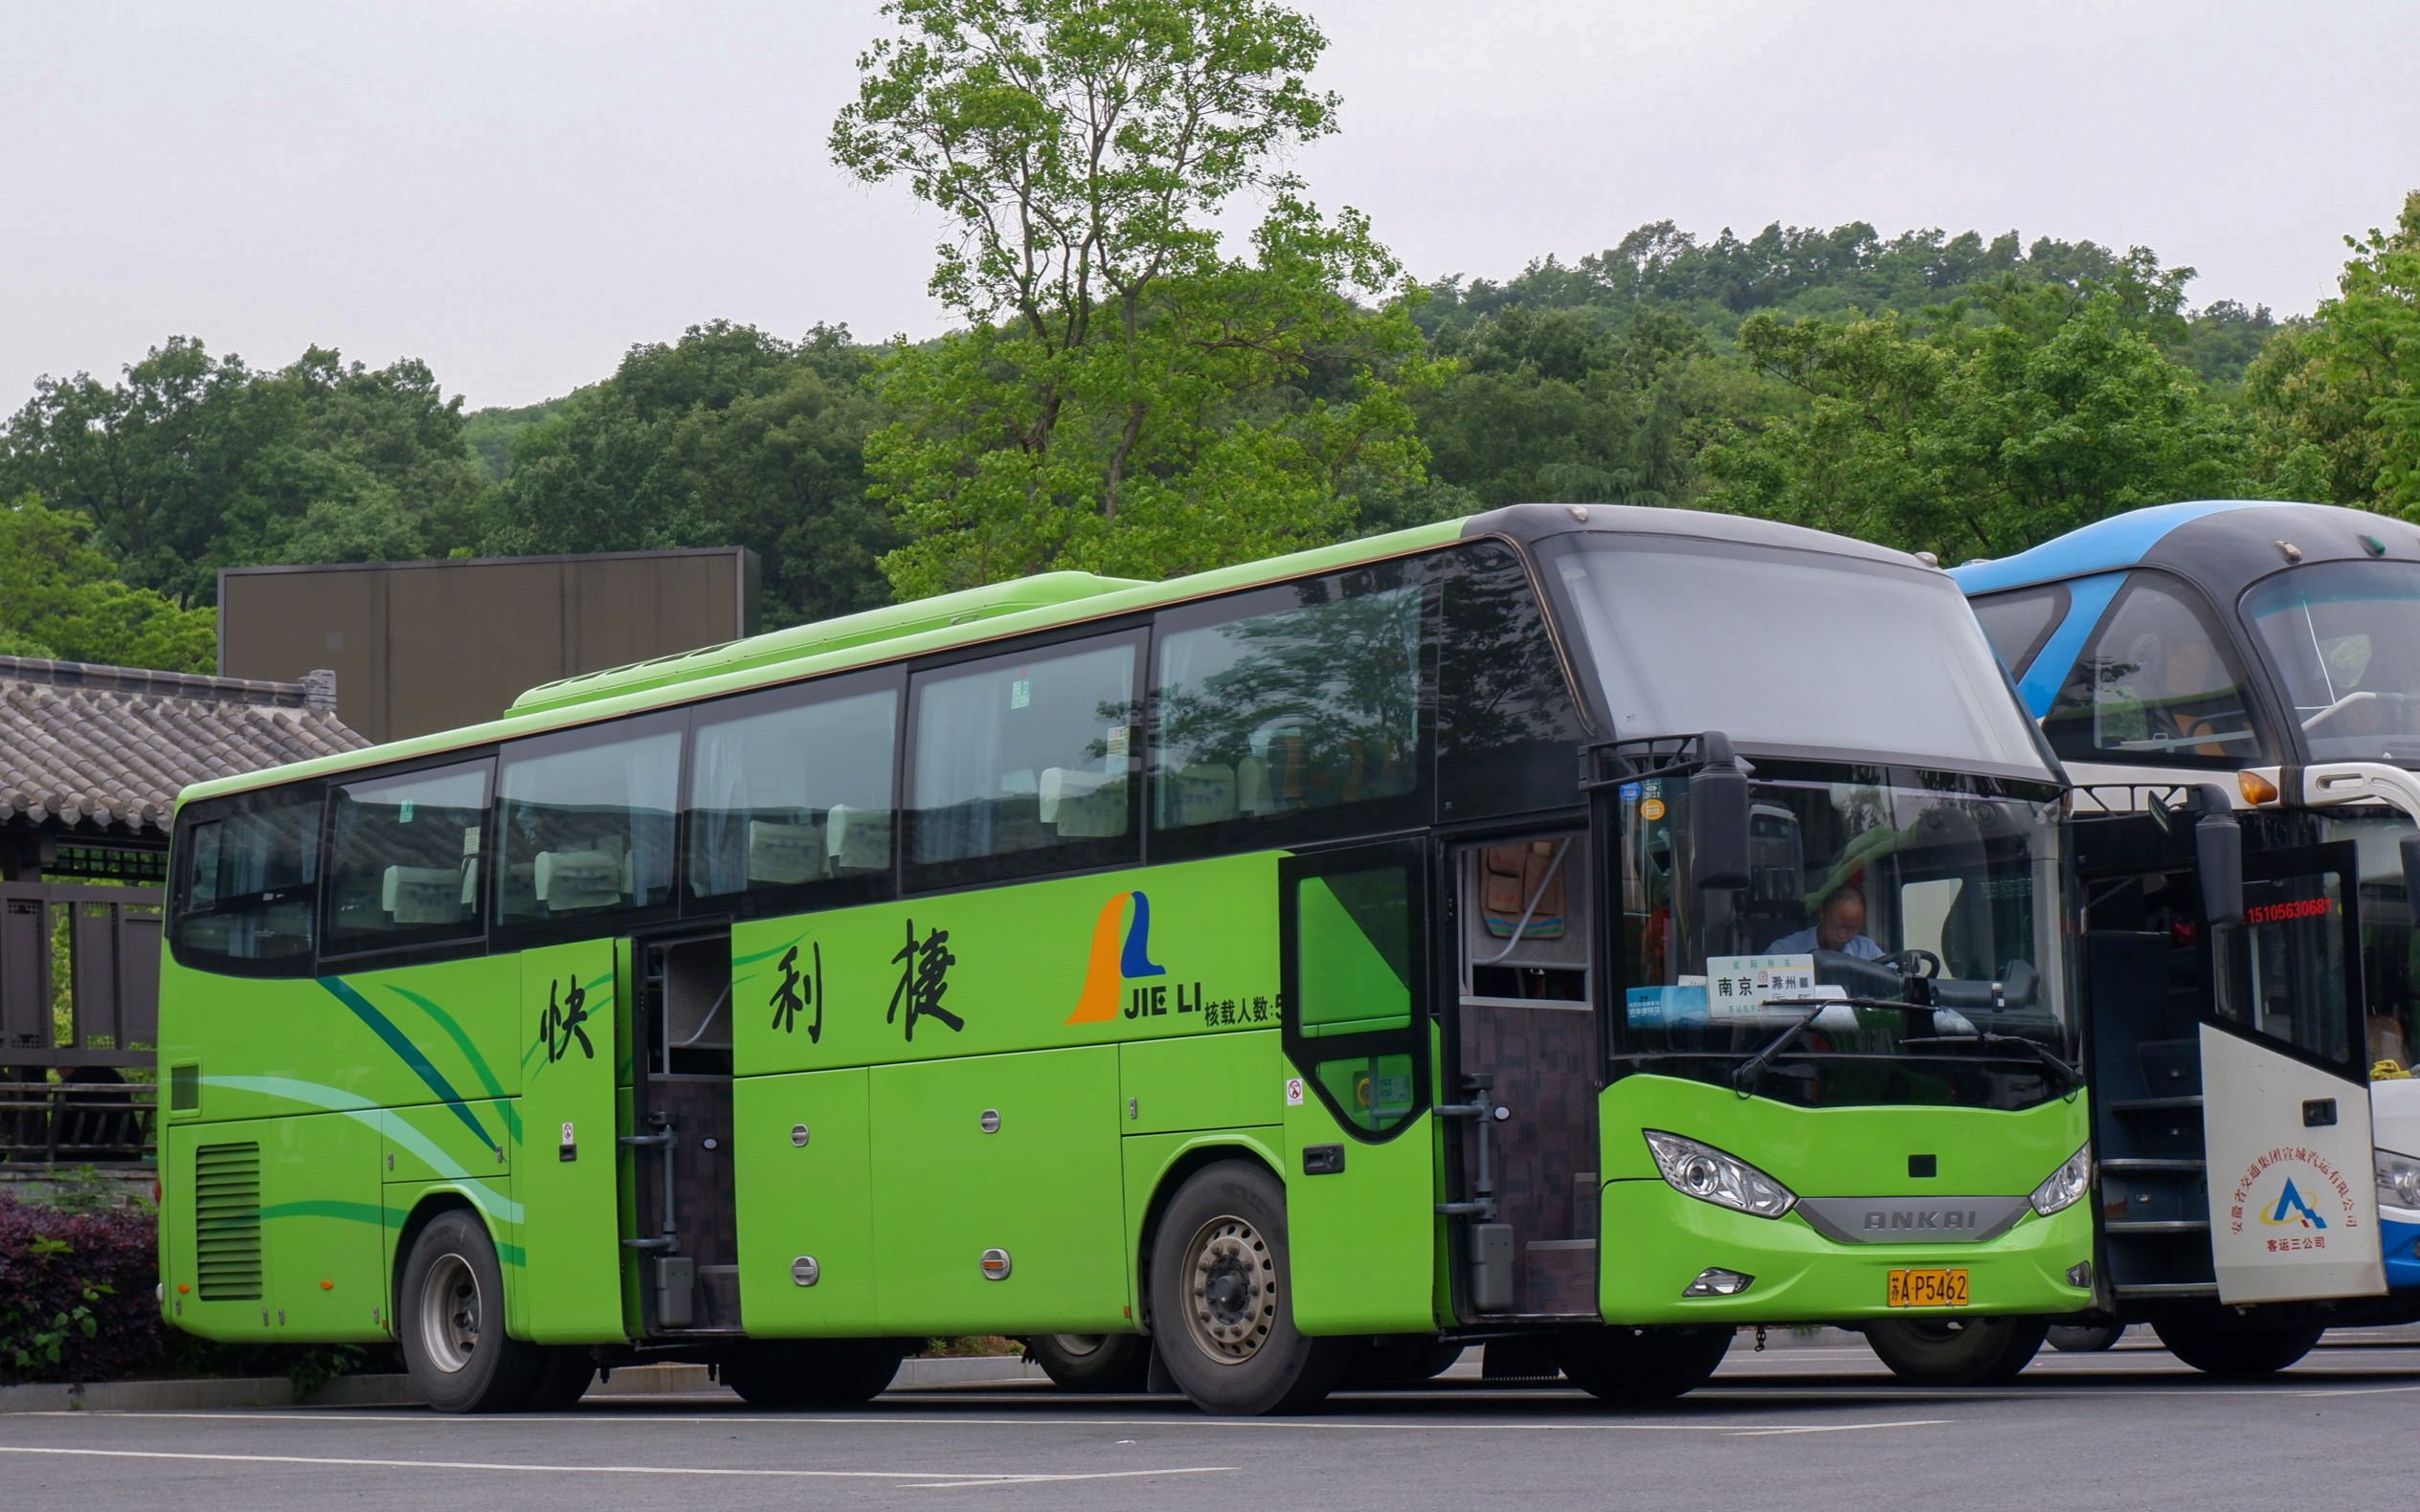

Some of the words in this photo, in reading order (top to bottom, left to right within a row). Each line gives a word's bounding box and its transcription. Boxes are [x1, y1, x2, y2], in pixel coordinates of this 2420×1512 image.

[2249, 897, 2333, 925] 15105630681
[1124, 986, 1167, 1019] JIE
[1177, 982, 1201, 1013] LI
[2231, 1146, 2358, 1234] 安徽省交通集团宣城汽运有限公司
[1863, 1211, 1977, 1231] ANKAI
[2267, 1236, 2325, 1252] 客运三公司
